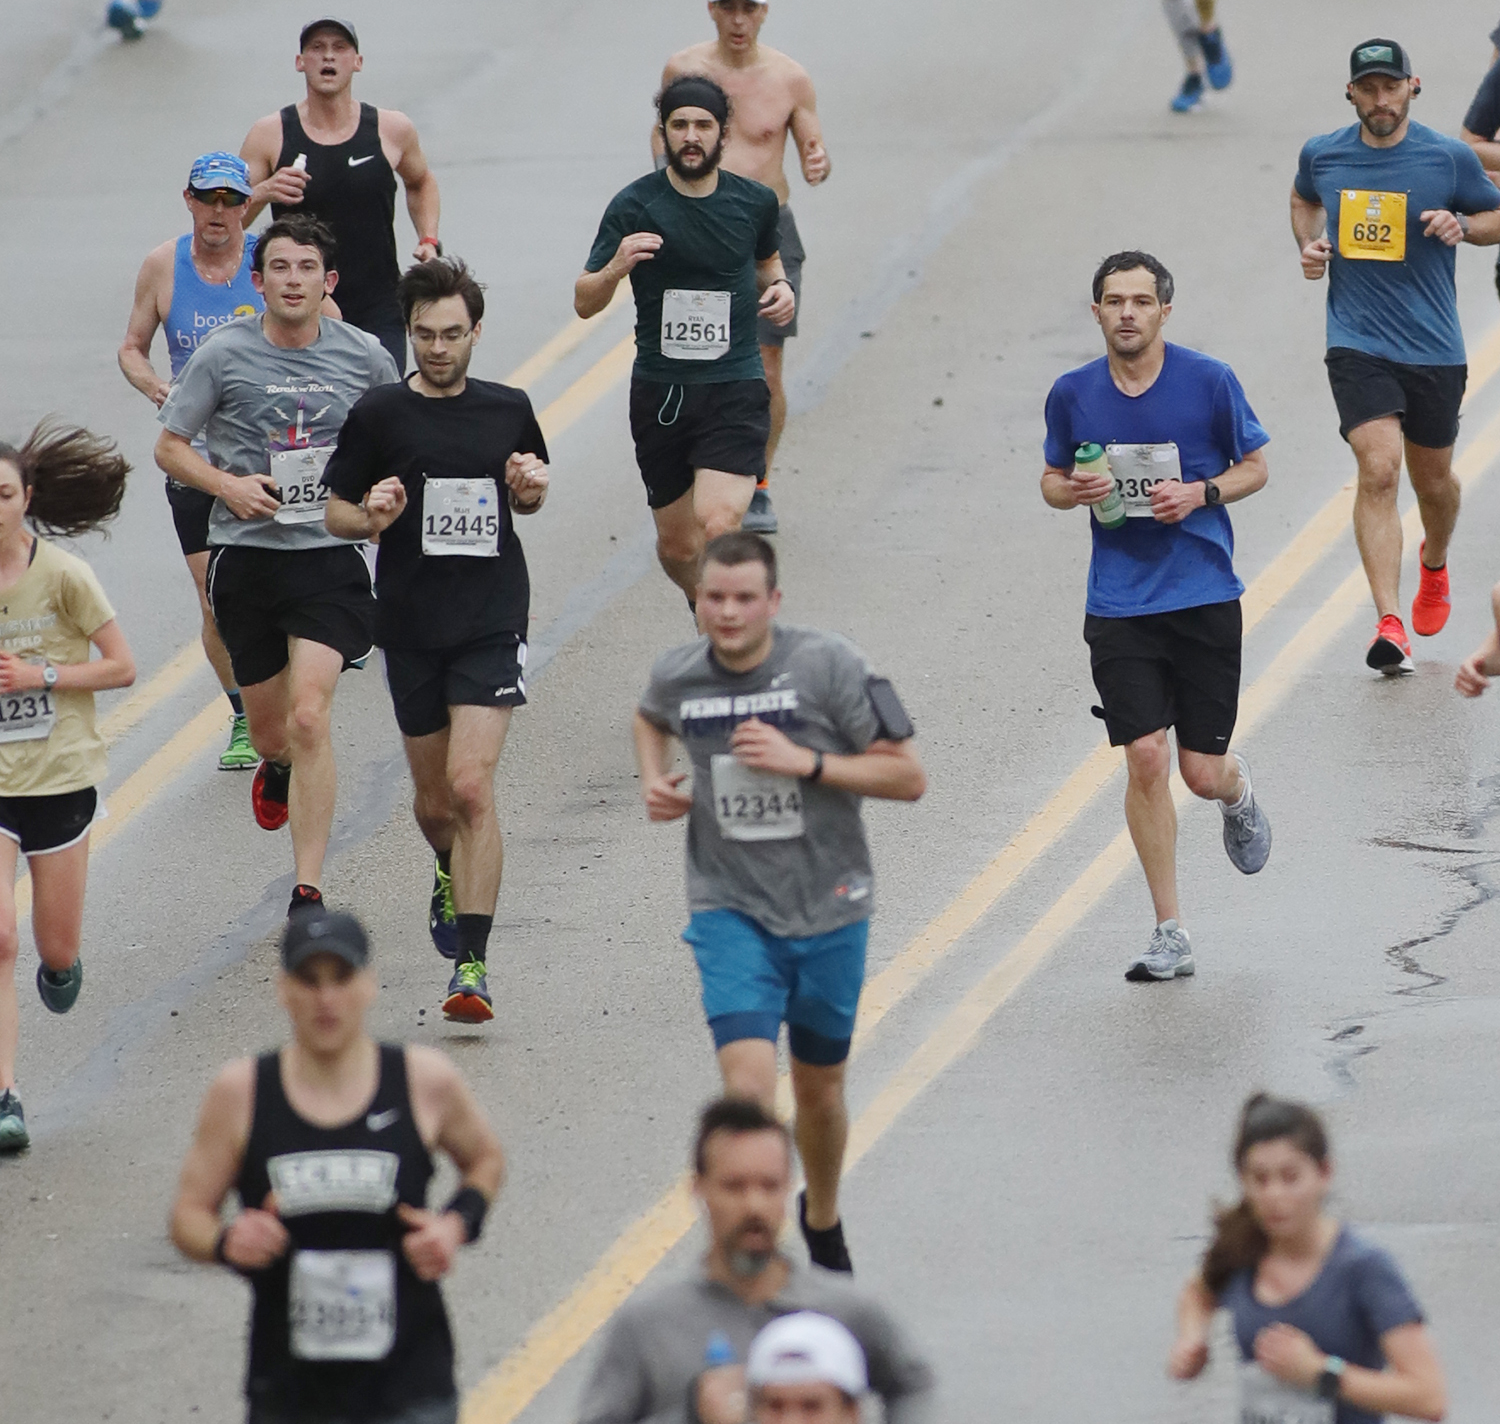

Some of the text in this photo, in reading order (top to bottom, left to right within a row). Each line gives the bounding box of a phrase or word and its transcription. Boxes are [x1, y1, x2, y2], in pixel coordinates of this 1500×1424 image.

[1353, 222, 1392, 243] 682
[663, 321, 728, 343] 12561
[425, 514, 498, 537] 12445
[679, 687, 799, 720] PENN STATE
[719, 792, 801, 819] 12344
